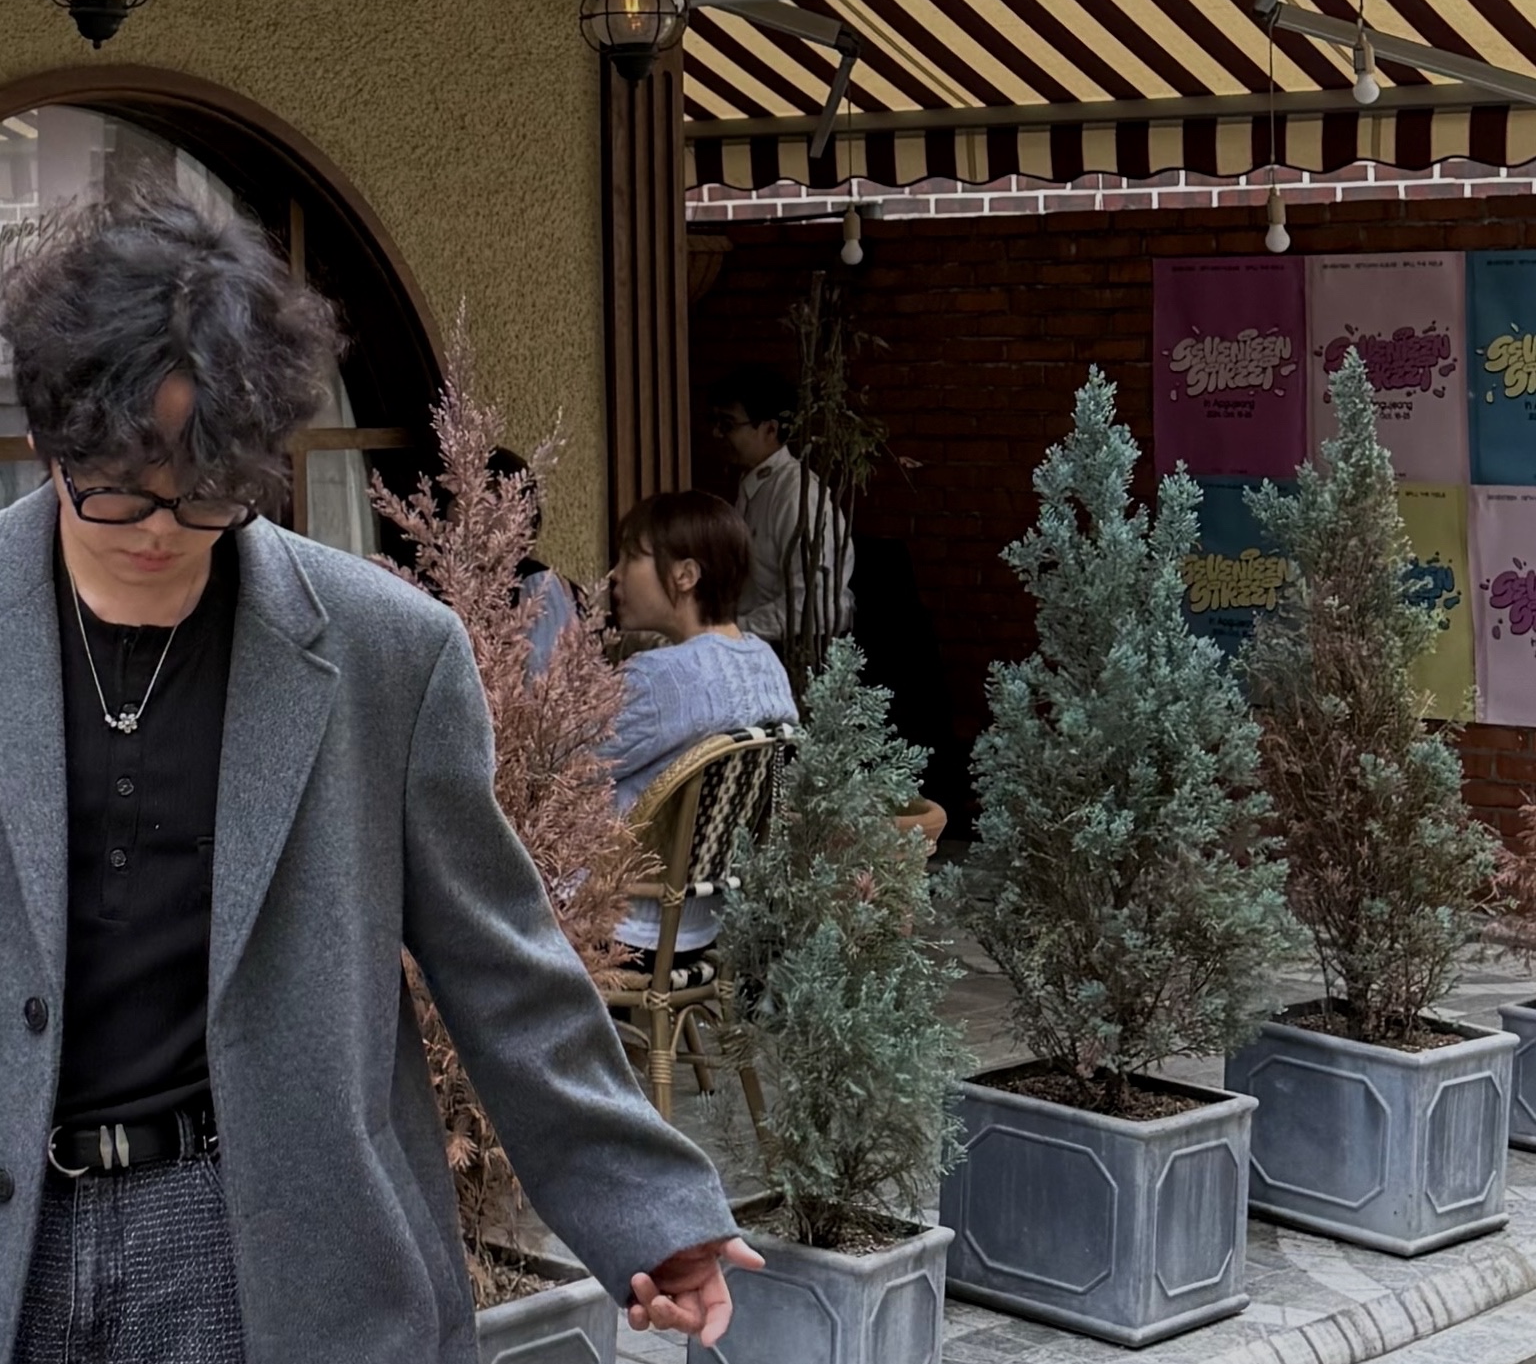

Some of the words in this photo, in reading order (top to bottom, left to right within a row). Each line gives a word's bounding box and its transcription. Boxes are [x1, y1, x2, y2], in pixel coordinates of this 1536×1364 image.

[1169, 328, 1292, 373] SEVENTEEN
[1186, 357, 1280, 397] STREET
[1190, 578, 1283, 614] STREET
